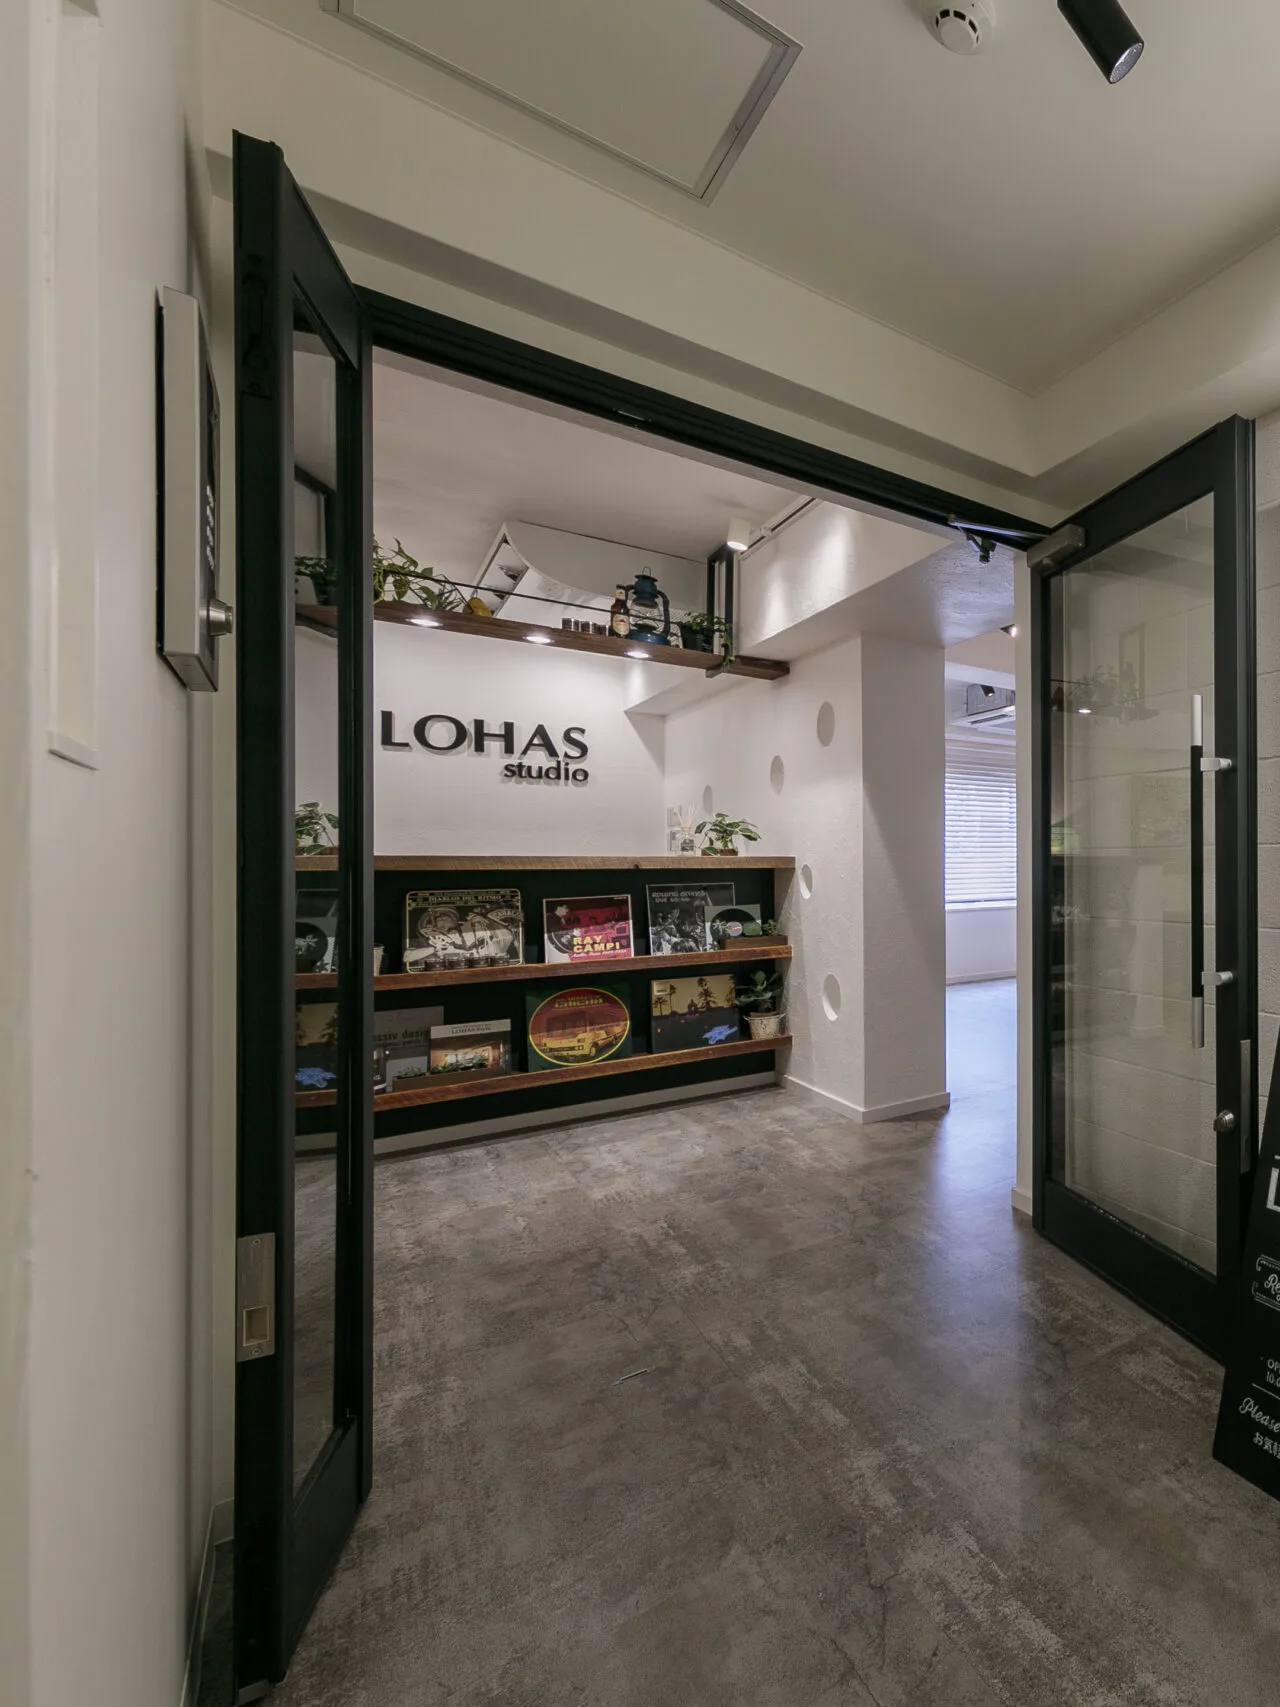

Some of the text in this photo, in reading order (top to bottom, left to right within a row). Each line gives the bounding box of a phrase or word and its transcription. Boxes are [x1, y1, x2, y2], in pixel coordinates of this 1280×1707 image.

[380, 710, 589, 760] LOHAS
[503, 760, 590, 782] studio
[573, 935, 602, 945] RAY
[573, 942, 620, 953] CAMPI
